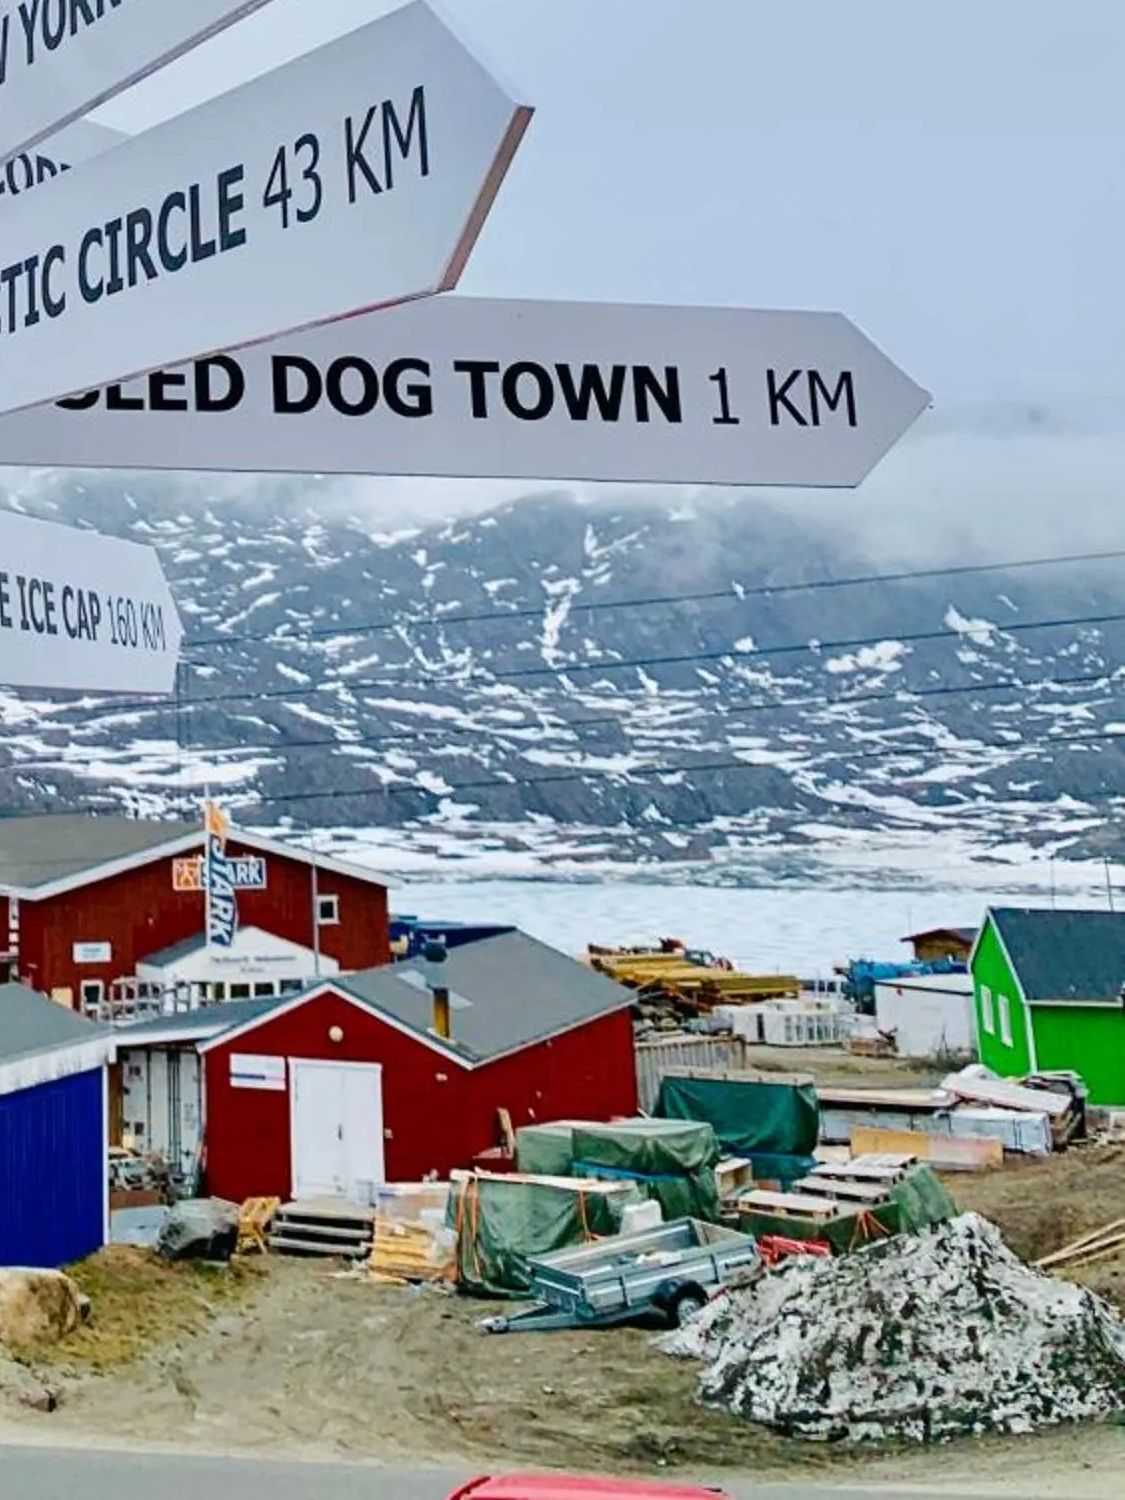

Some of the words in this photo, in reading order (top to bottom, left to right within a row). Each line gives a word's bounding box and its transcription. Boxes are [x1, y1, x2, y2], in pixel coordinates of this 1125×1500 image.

[77, 163, 248, 303] CIRCLE
[262, 132, 323, 229] 43
[344, 85, 429, 204] KM
[272, 355, 433, 418] DOG
[454, 360, 683, 424] TOWN
[708, 368, 742, 426] 1
[767, 368, 858, 428] KM
[16, 575, 58, 636] ICE
[62, 585, 101, 641] CAP
[107, 596, 138, 648] 160
[140, 600, 167, 652] KM
